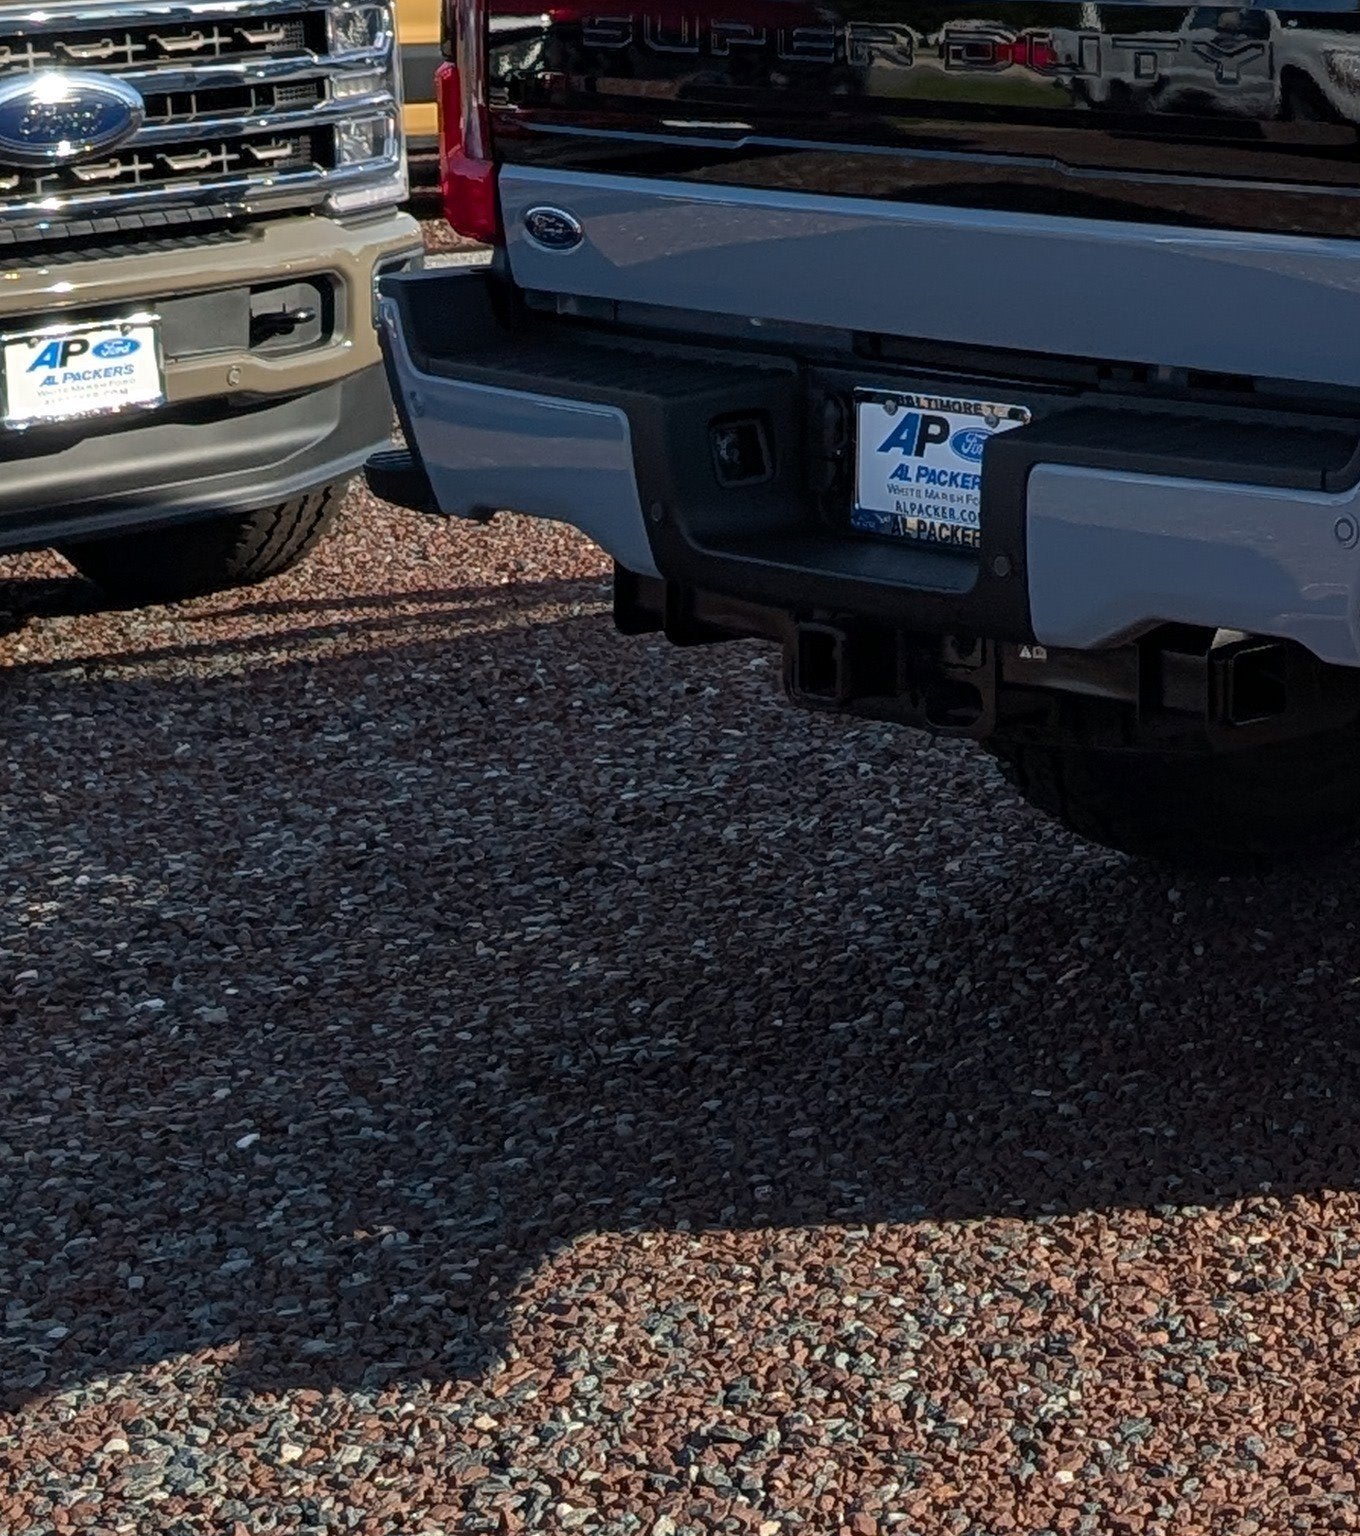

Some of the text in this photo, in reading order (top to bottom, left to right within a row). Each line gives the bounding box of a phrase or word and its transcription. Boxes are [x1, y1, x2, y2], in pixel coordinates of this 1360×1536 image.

[582, 15, 1270, 86] SUPER DUTY
[26, 339, 90, 372] AP
[877, 412, 951, 458] AP
[889, 463, 912, 482] AL
[896, 500, 980, 524] ALPACKER.CO
